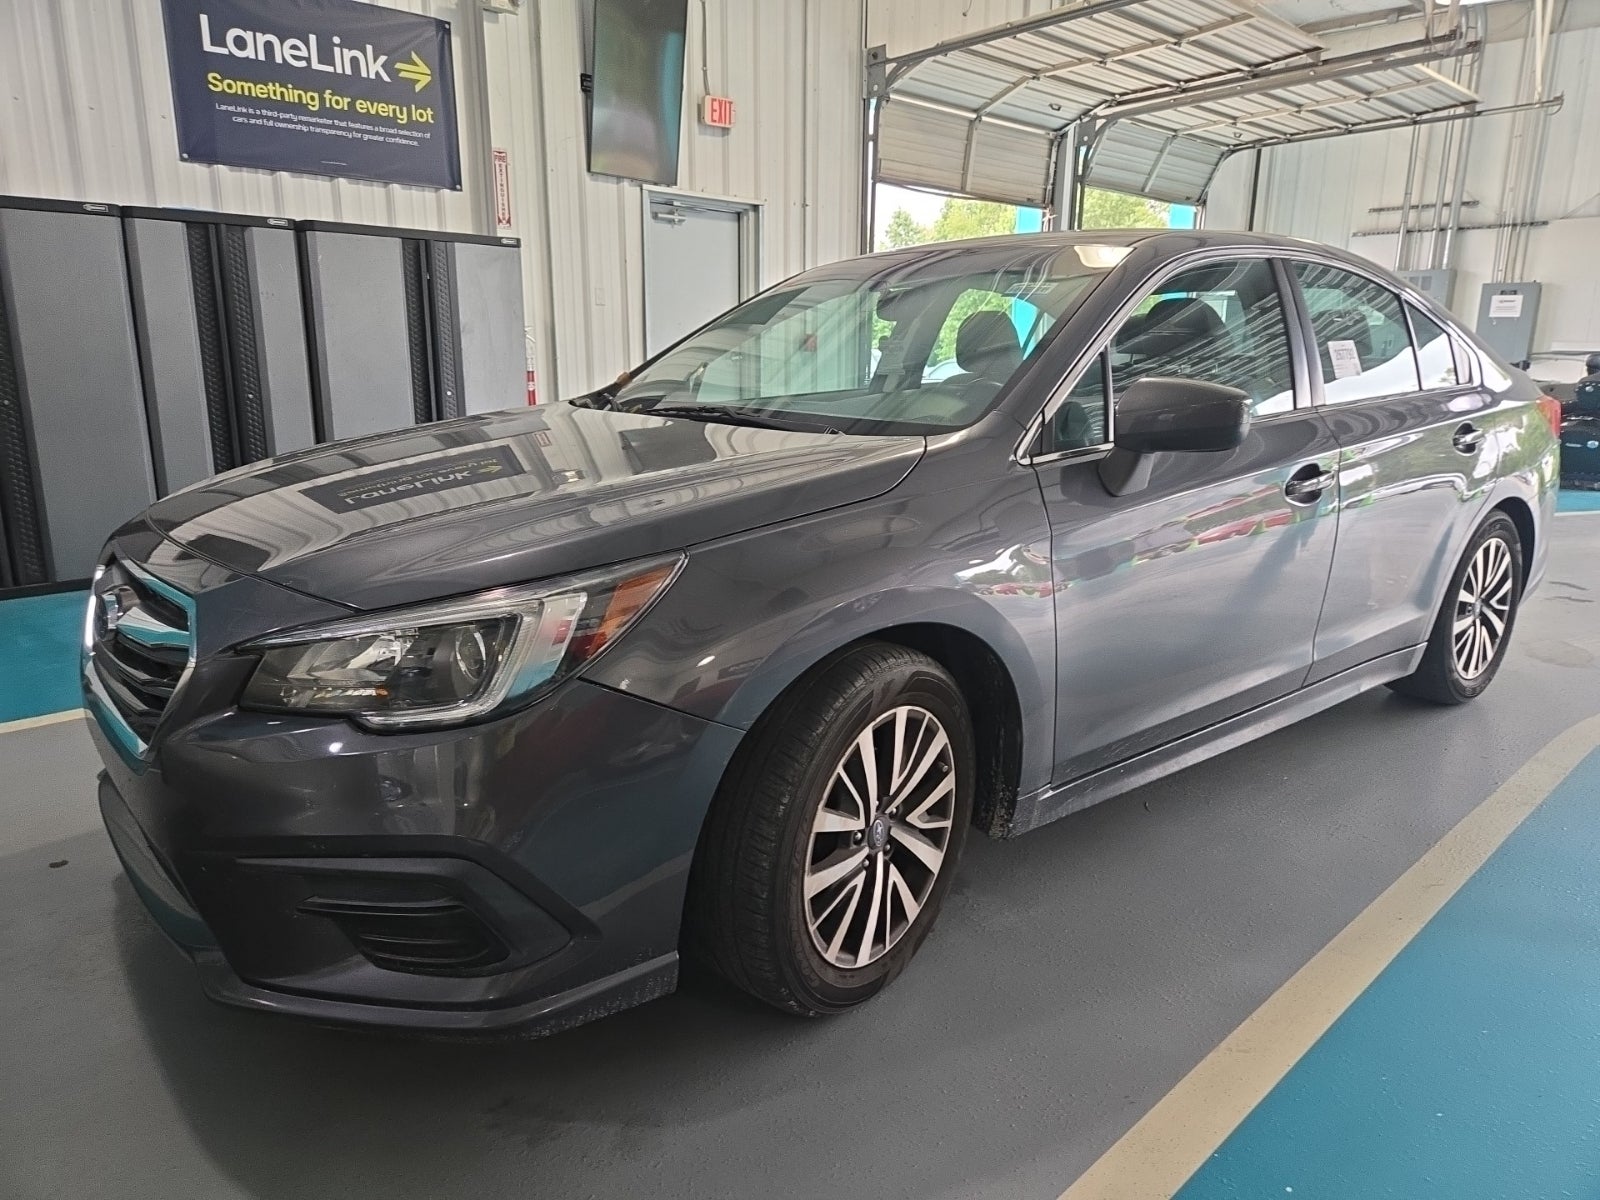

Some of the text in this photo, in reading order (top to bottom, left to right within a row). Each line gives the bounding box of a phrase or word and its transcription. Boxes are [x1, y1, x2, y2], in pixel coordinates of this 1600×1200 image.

[199, 13, 392, 83] LaneLink
[207, 72, 434, 124] Something for every lot
[711, 97, 733, 126] EXIT
[215, 102, 248, 113] LaneLink
[261, 109, 298, 122] third-party
[334, 119, 347, 127] that
[348, 120, 374, 131] features
[379, 126, 397, 134] broad
[398, 128, 424, 138] selection
[232, 116, 420, 147] cars and full ownership transparency for greater confidence.
